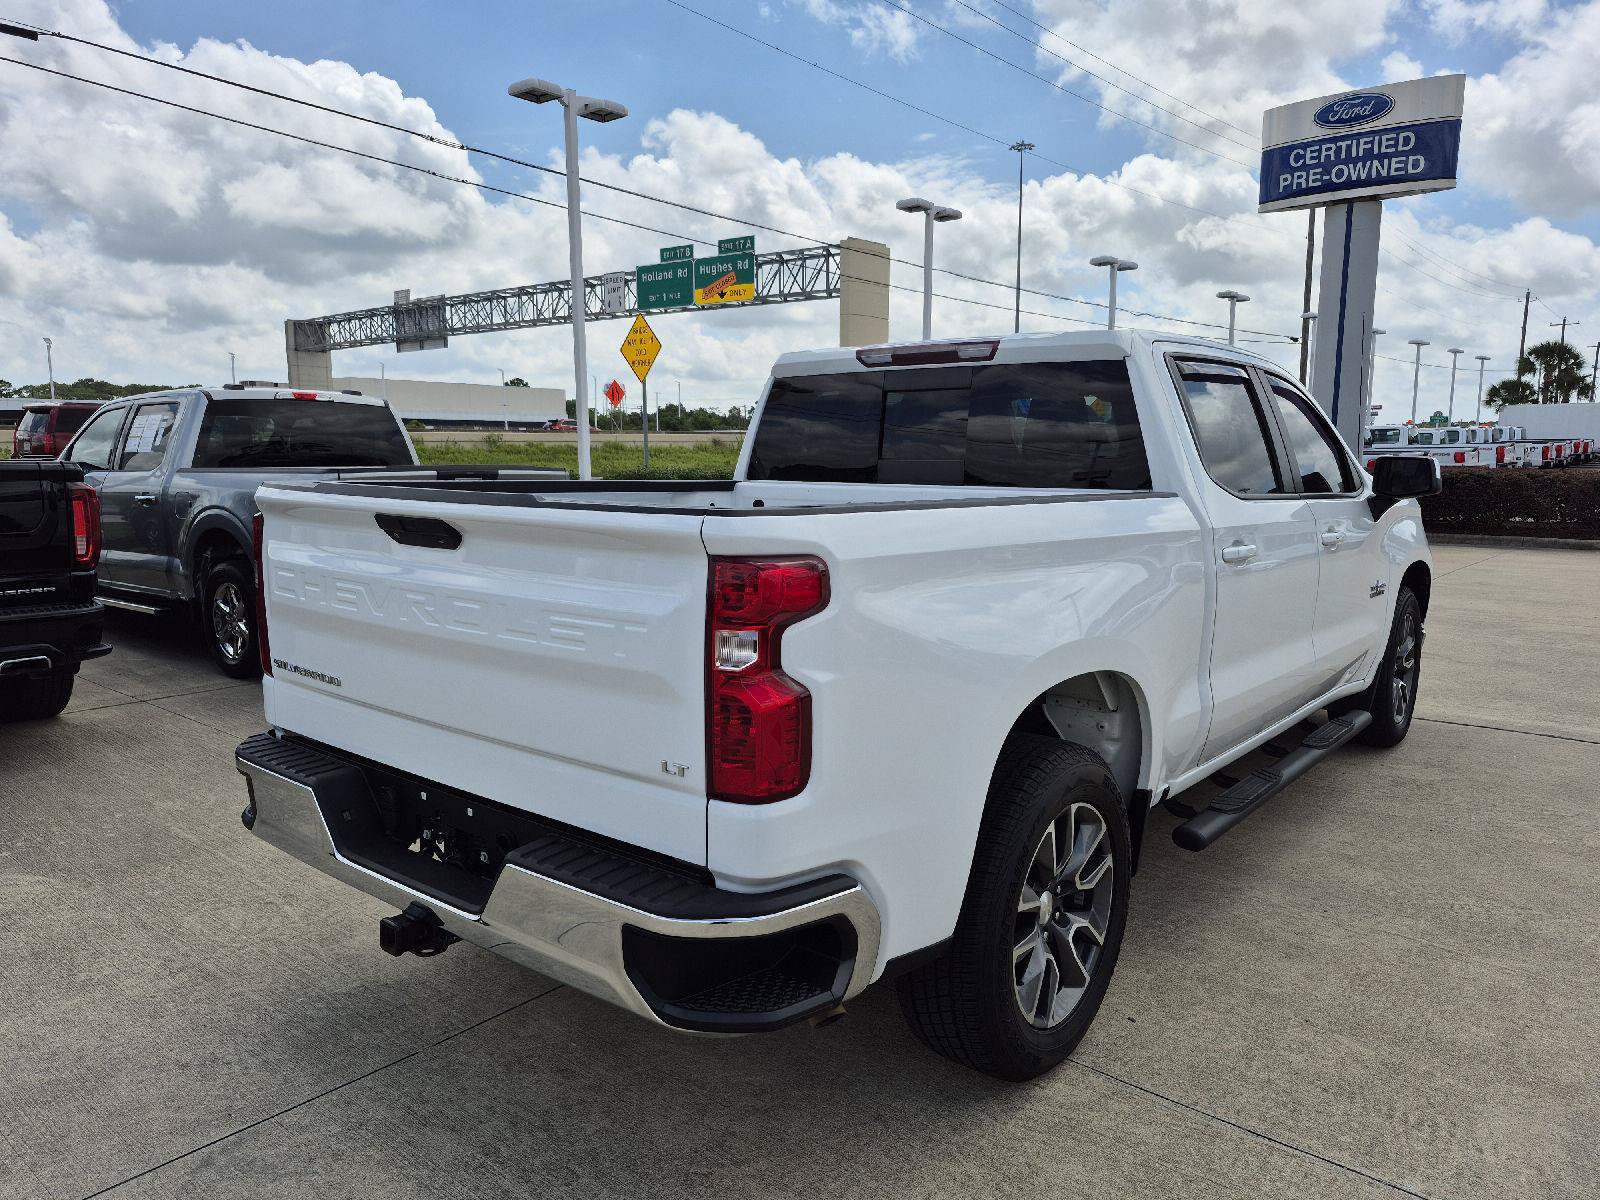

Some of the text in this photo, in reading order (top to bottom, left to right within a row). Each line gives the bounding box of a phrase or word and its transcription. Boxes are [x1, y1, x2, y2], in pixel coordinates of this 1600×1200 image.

[1329, 98, 1374, 122] Ford
[1290, 131, 1416, 168] CERTIFIED
[1279, 155, 1425, 193] PRE-OWNED
[642, 267, 688, 282] Holland Rd
[699, 259, 749, 275] Hughes Rd
[605, 276, 623, 284] SPEED
[715, 275, 735, 290] CLOSED
[608, 286, 622, 294] LIMIT
[273, 566, 649, 658] CHEVROLET
[661, 759, 690, 778] LT
